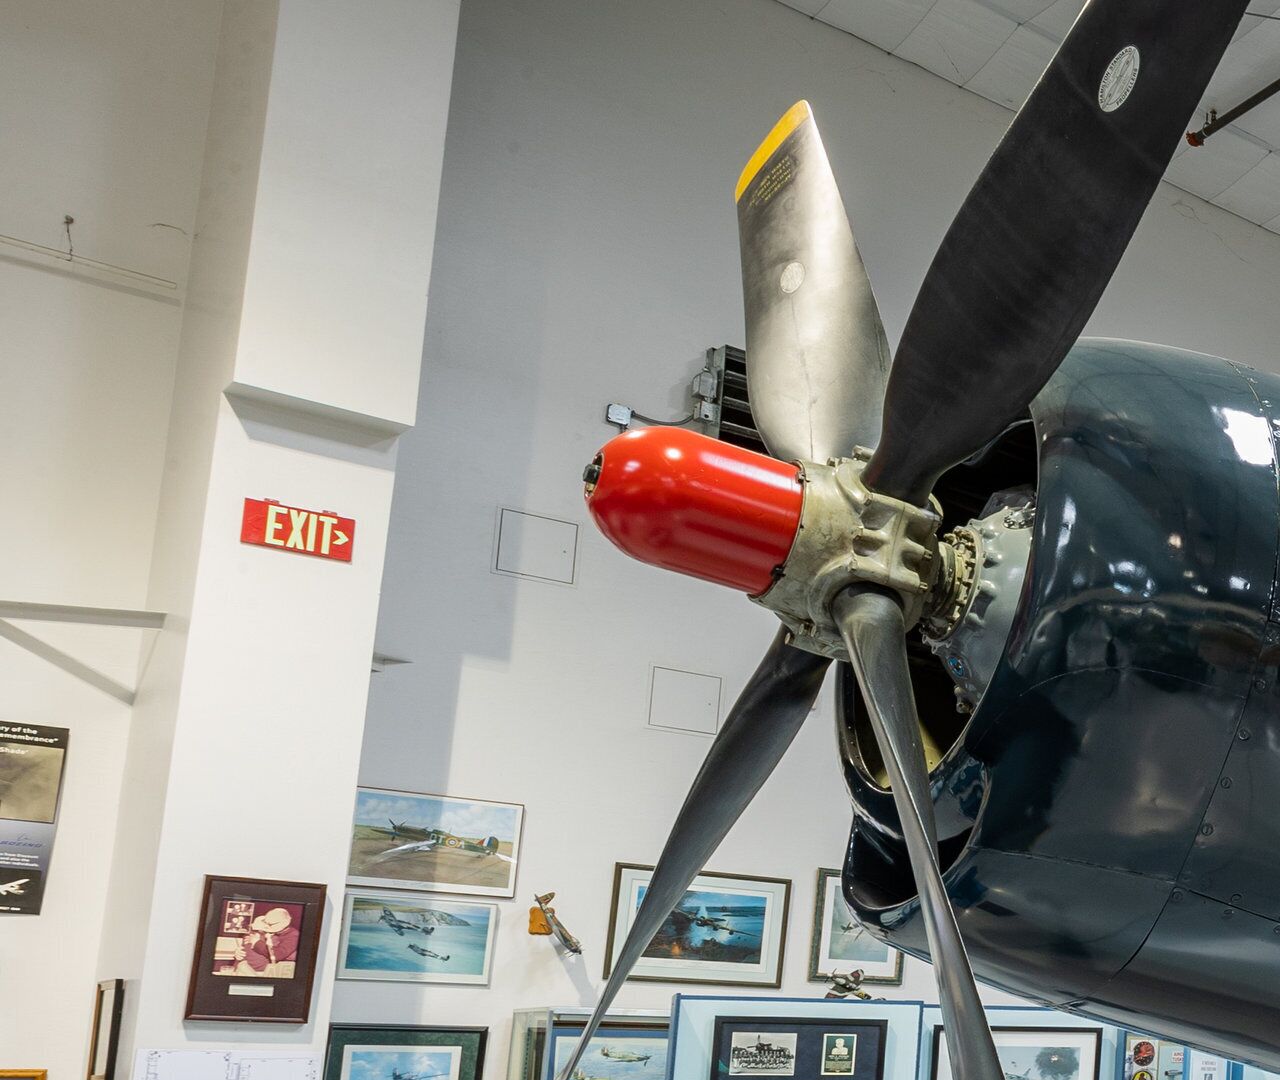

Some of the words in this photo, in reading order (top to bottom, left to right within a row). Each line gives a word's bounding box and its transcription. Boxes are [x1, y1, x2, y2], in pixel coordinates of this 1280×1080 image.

[1099, 71, 1111, 104] HAMILTON
[1109, 47, 1133, 70] STANDARD
[1116, 68, 1138, 106] PROPELLERS
[264, 504, 338, 555] EXIT
[23, 727, 37, 735] the
